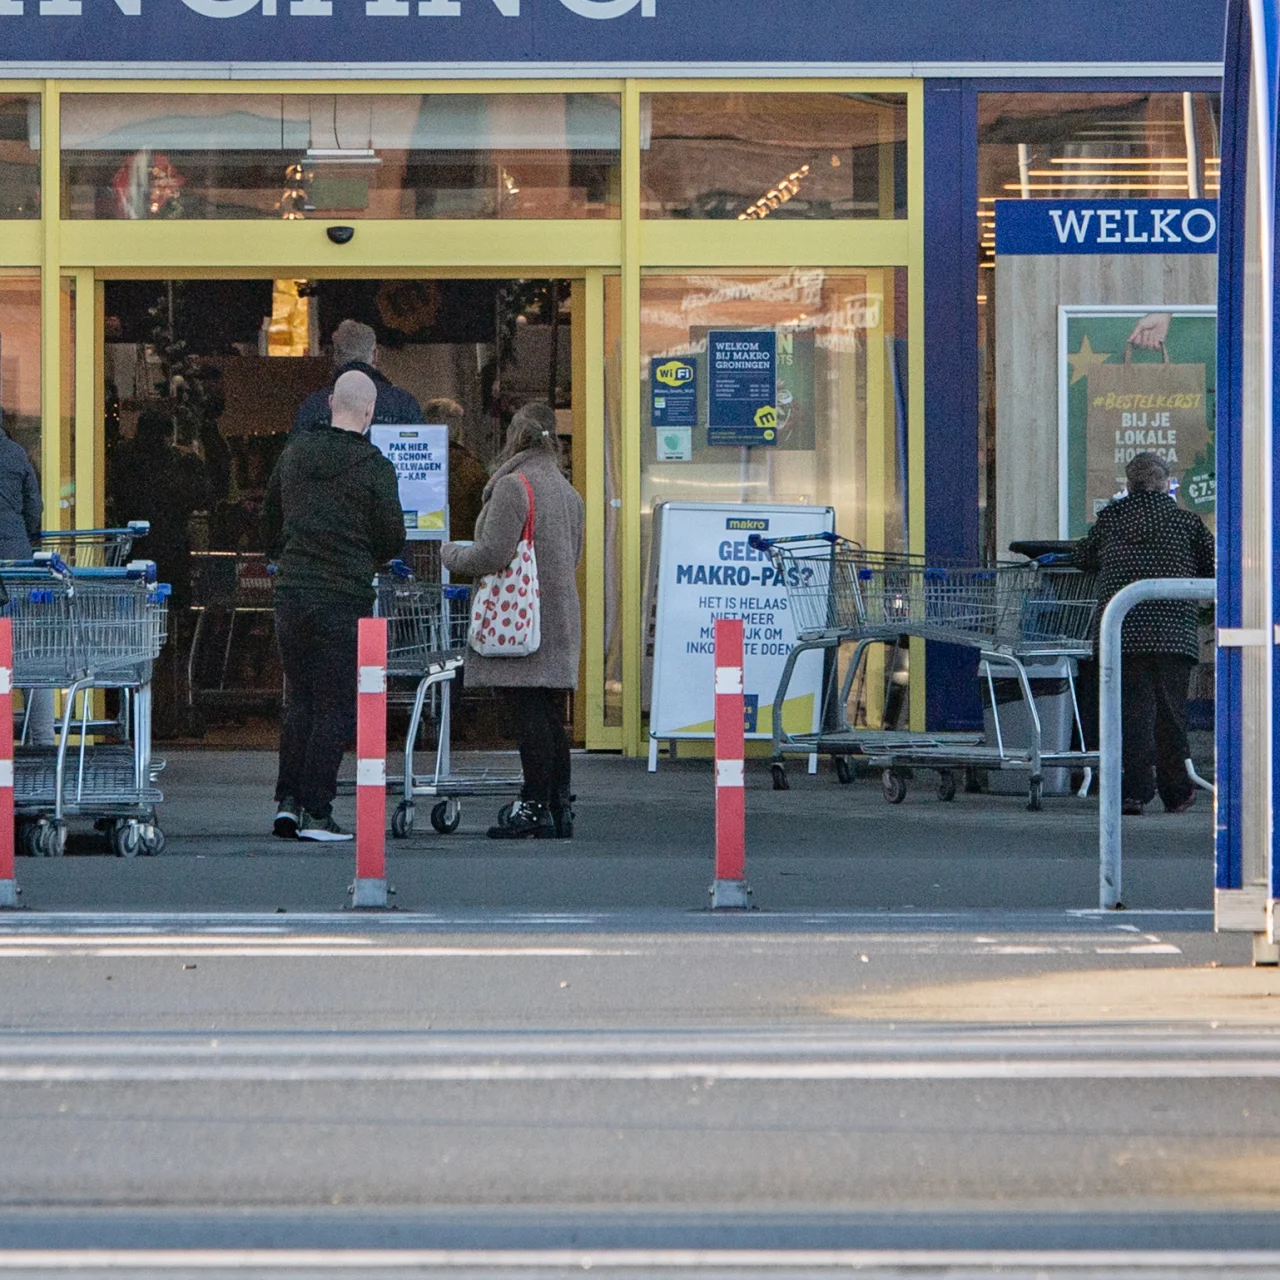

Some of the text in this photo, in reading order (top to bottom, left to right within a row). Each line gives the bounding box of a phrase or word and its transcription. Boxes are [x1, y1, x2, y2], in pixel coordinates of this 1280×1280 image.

[1049, 208, 1217, 243] WELKO
[716, 342, 759, 350] WELKOM
[716, 352, 730, 360] BIJ
[733, 352, 770, 360] MAKRO
[716, 361, 770, 369] GRONINGEN
[1122, 412, 1170, 427] BIJ JE
[1115, 430, 1177, 445] LOKALE
[389, 443, 428, 451] PAK HIER
[398, 453, 432, 461] SCHONE
[1115, 448, 1178, 462] HOCA
[394, 463, 441, 471] KELWAGEN
[404, 473, 427, 481] -KAR
[729, 520, 765, 529] makro
[676, 564, 814, 587] MAKRO-PAS?
[699, 596, 787, 610] HET IS HELAAS
[741, 613, 774, 625] MEER
[764, 628, 782, 640] OM
[687, 642, 794, 655] INKO TE DOEN
